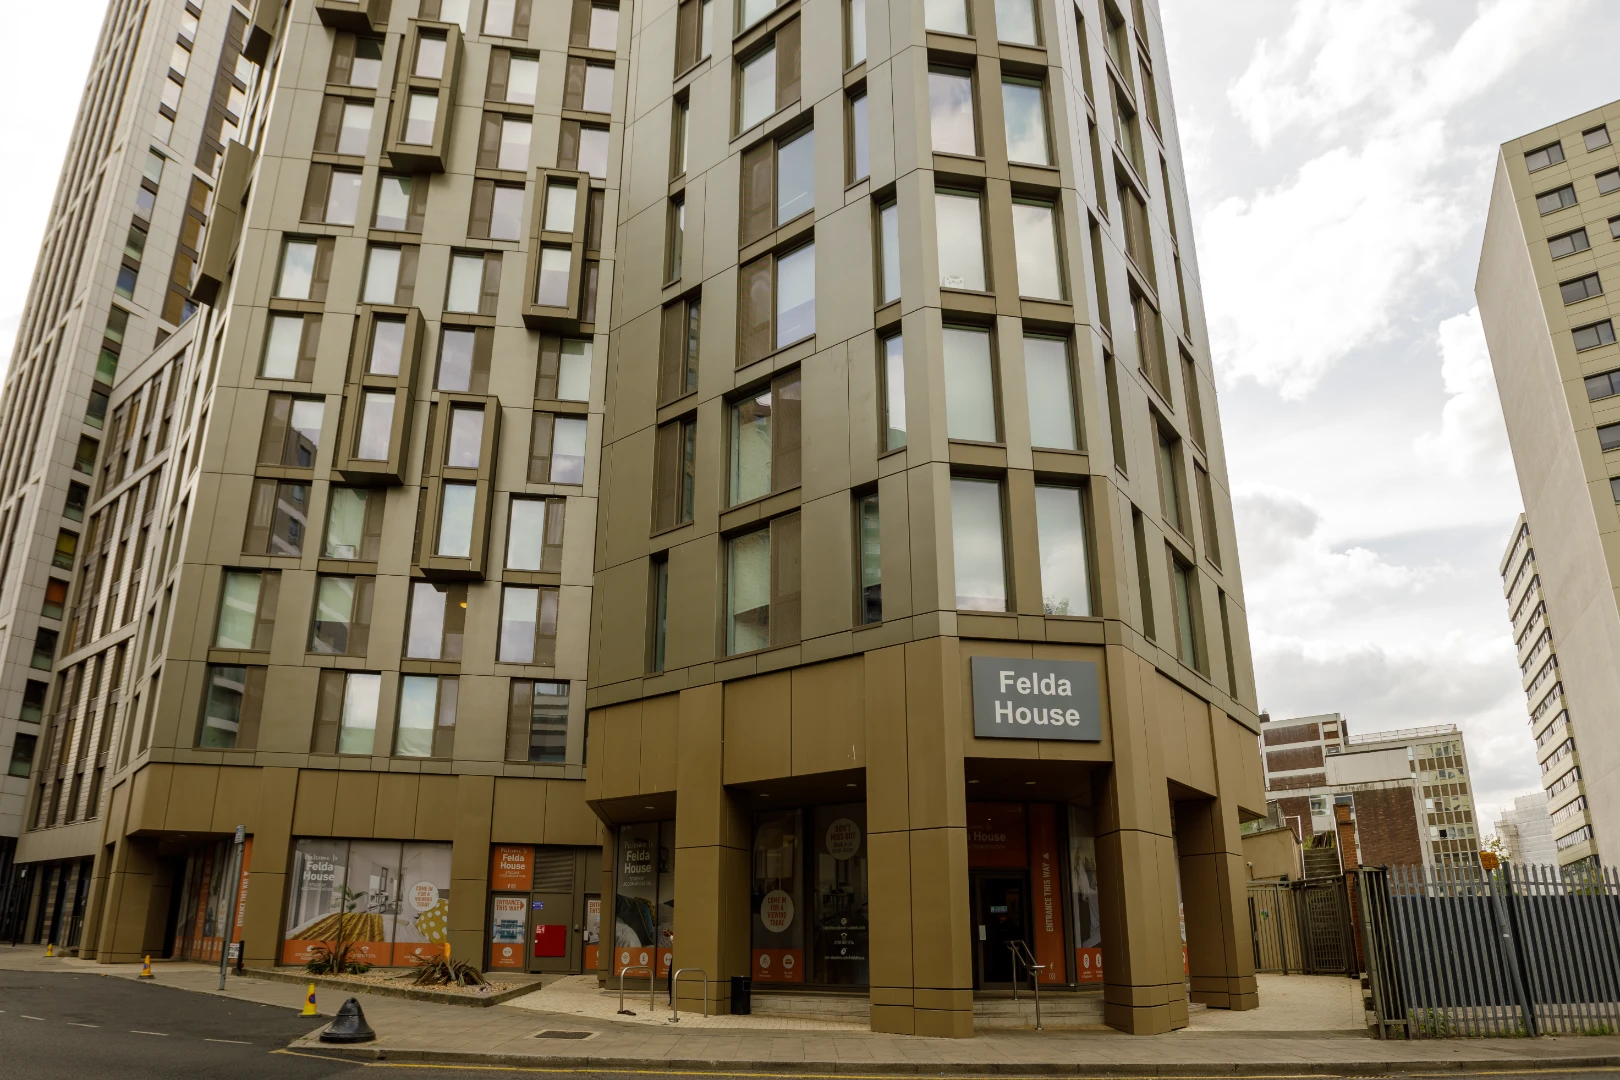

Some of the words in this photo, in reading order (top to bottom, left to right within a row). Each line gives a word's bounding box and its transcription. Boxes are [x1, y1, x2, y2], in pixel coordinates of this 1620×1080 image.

[1000, 671, 1072, 696] Felda
[995, 700, 1080, 726] House
[973, 831, 1006, 842] House
[502, 853, 525, 862] Felda
[626, 850, 650, 861] Felda
[306, 862, 334, 871] Felda
[500, 861, 526, 870] House
[624, 862, 652, 873] House
[1042, 863, 1050, 878] WAY
[303, 871, 335, 881] House
[1043, 879, 1051, 896] THIS
[767, 896, 781, 904] COME
[237, 902, 246, 927] ENTRANCE
[1045, 898, 1053, 932] ENTRANCE
